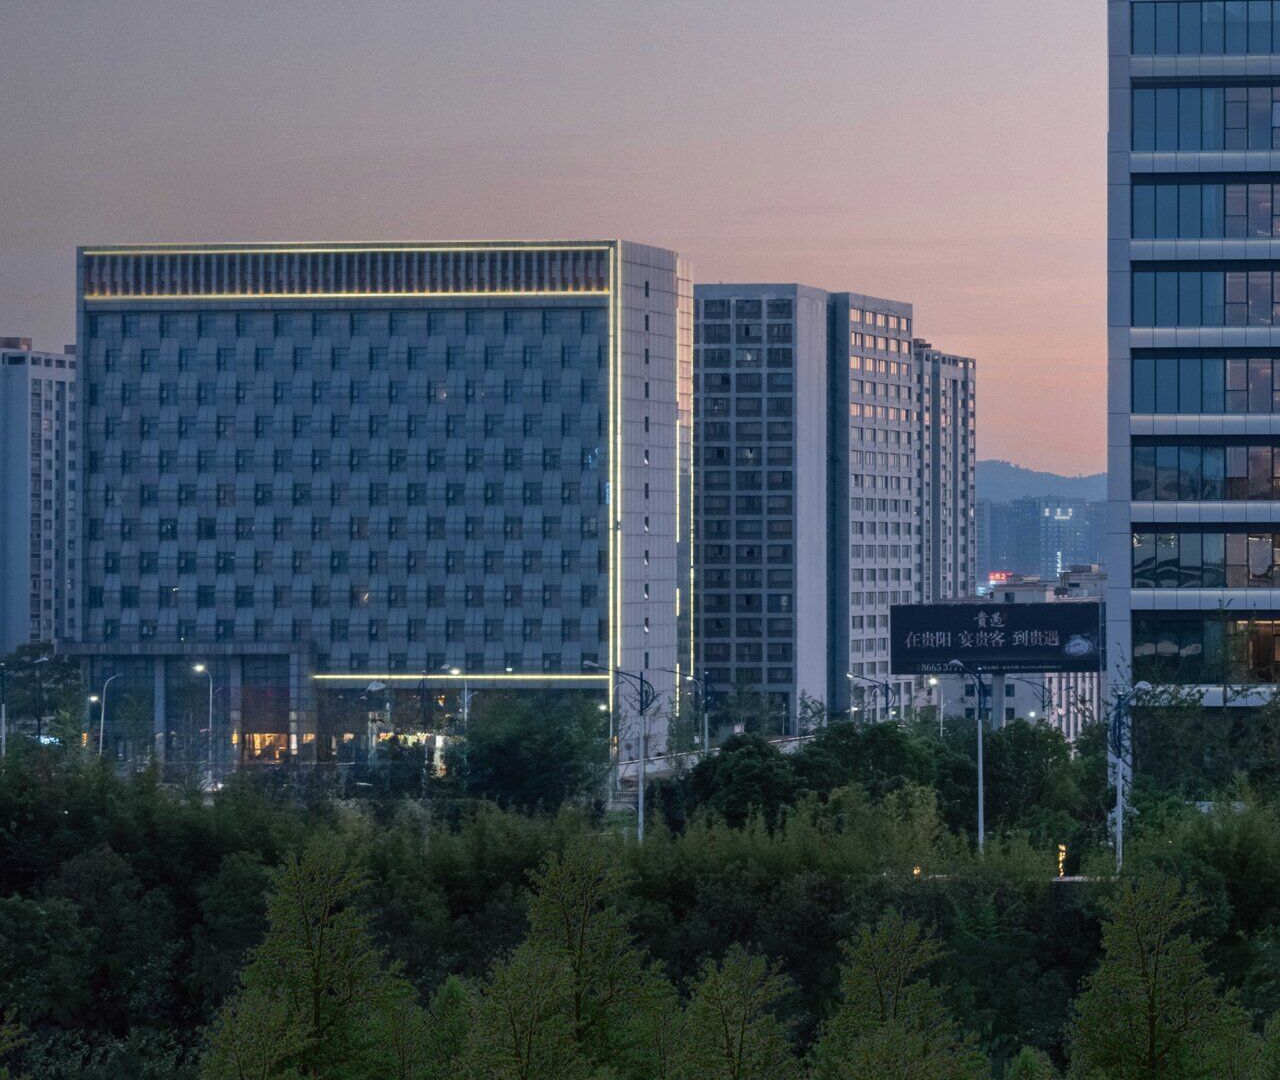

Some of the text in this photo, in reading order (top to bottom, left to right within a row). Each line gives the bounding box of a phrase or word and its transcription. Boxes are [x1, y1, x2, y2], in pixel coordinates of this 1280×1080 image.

[905, 630, 1060, 648] 在贵阳 宴贵客 到贵遇
